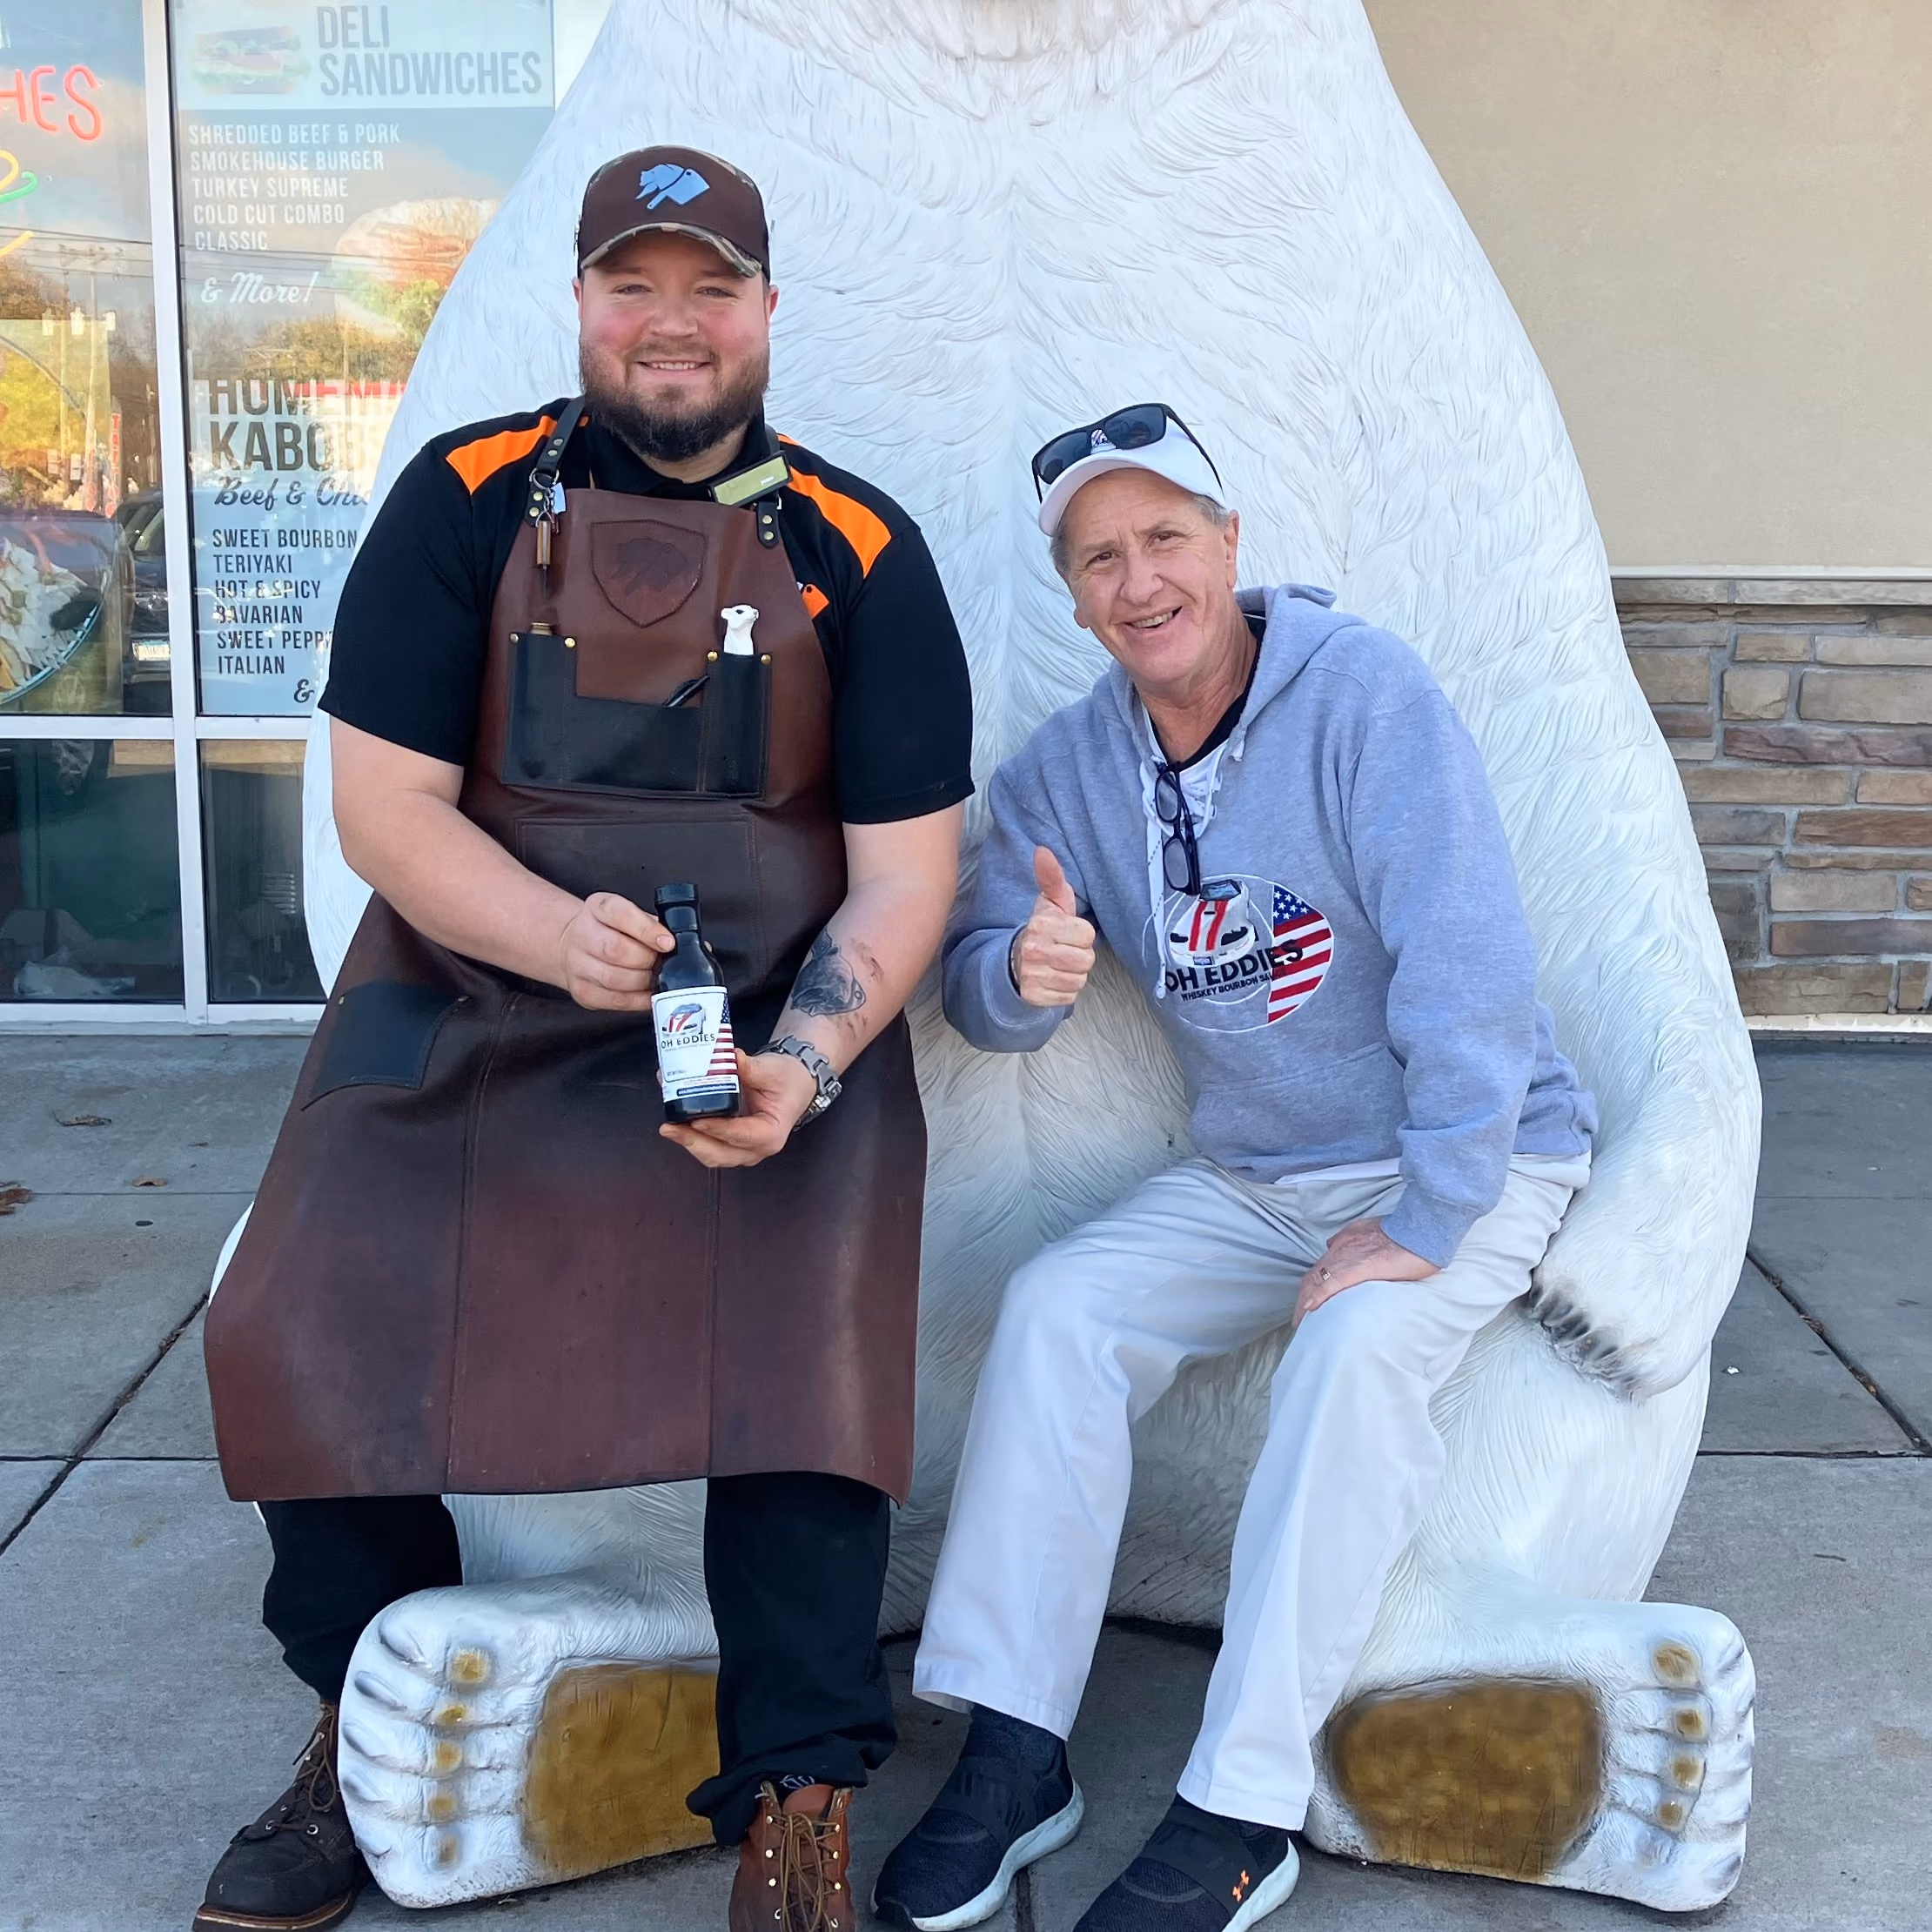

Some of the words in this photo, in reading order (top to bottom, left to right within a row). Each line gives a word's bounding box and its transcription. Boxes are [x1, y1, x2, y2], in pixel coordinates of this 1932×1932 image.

[316, 5, 390, 49] DELI
[319, 50, 542, 96] SANDWICHES
[189, 124, 282, 144] SHREDDED
[288, 124, 331, 144] BEEF
[338, 124, 348, 144] &
[355, 124, 400, 144] PORK
[190, 151, 308, 171] SMOKEHOUSE
[316, 150, 384, 171] BURGER
[191, 177, 259, 198] TURKEY
[267, 177, 348, 198] SUPREME
[193, 204, 238, 225] COLD
[245, 204, 276, 224] CUT
[285, 204, 344, 224] COMBO
[195, 231, 268, 251] CLASSIC
[201, 277, 223, 303] &
[229, 271, 319, 304] More!
[214, 476, 279, 511] Beef
[285, 480, 306, 506] &
[212, 528, 270, 548] SWEET
[278, 529, 357, 548] BOURBON
[213, 554, 292, 574] TERIYAKI
[216, 580, 248, 599] HOT
[272, 580, 321, 599] SPICY
[216, 605, 303, 624] BAVARIAN
[218, 630, 274, 649] SWEET
[218, 655, 285, 674] ITALIAN
[293, 678, 315, 703] &
[1165, 966, 1199, 992] OH
[1204, 938, 1304, 987] EDDIES
[1180, 987, 1218, 1002] WHISKEY
[1218, 976, 1258, 994] BOURBON
[661, 1039, 673, 1049] OH
[677, 1033, 715, 1046] EDDIES
